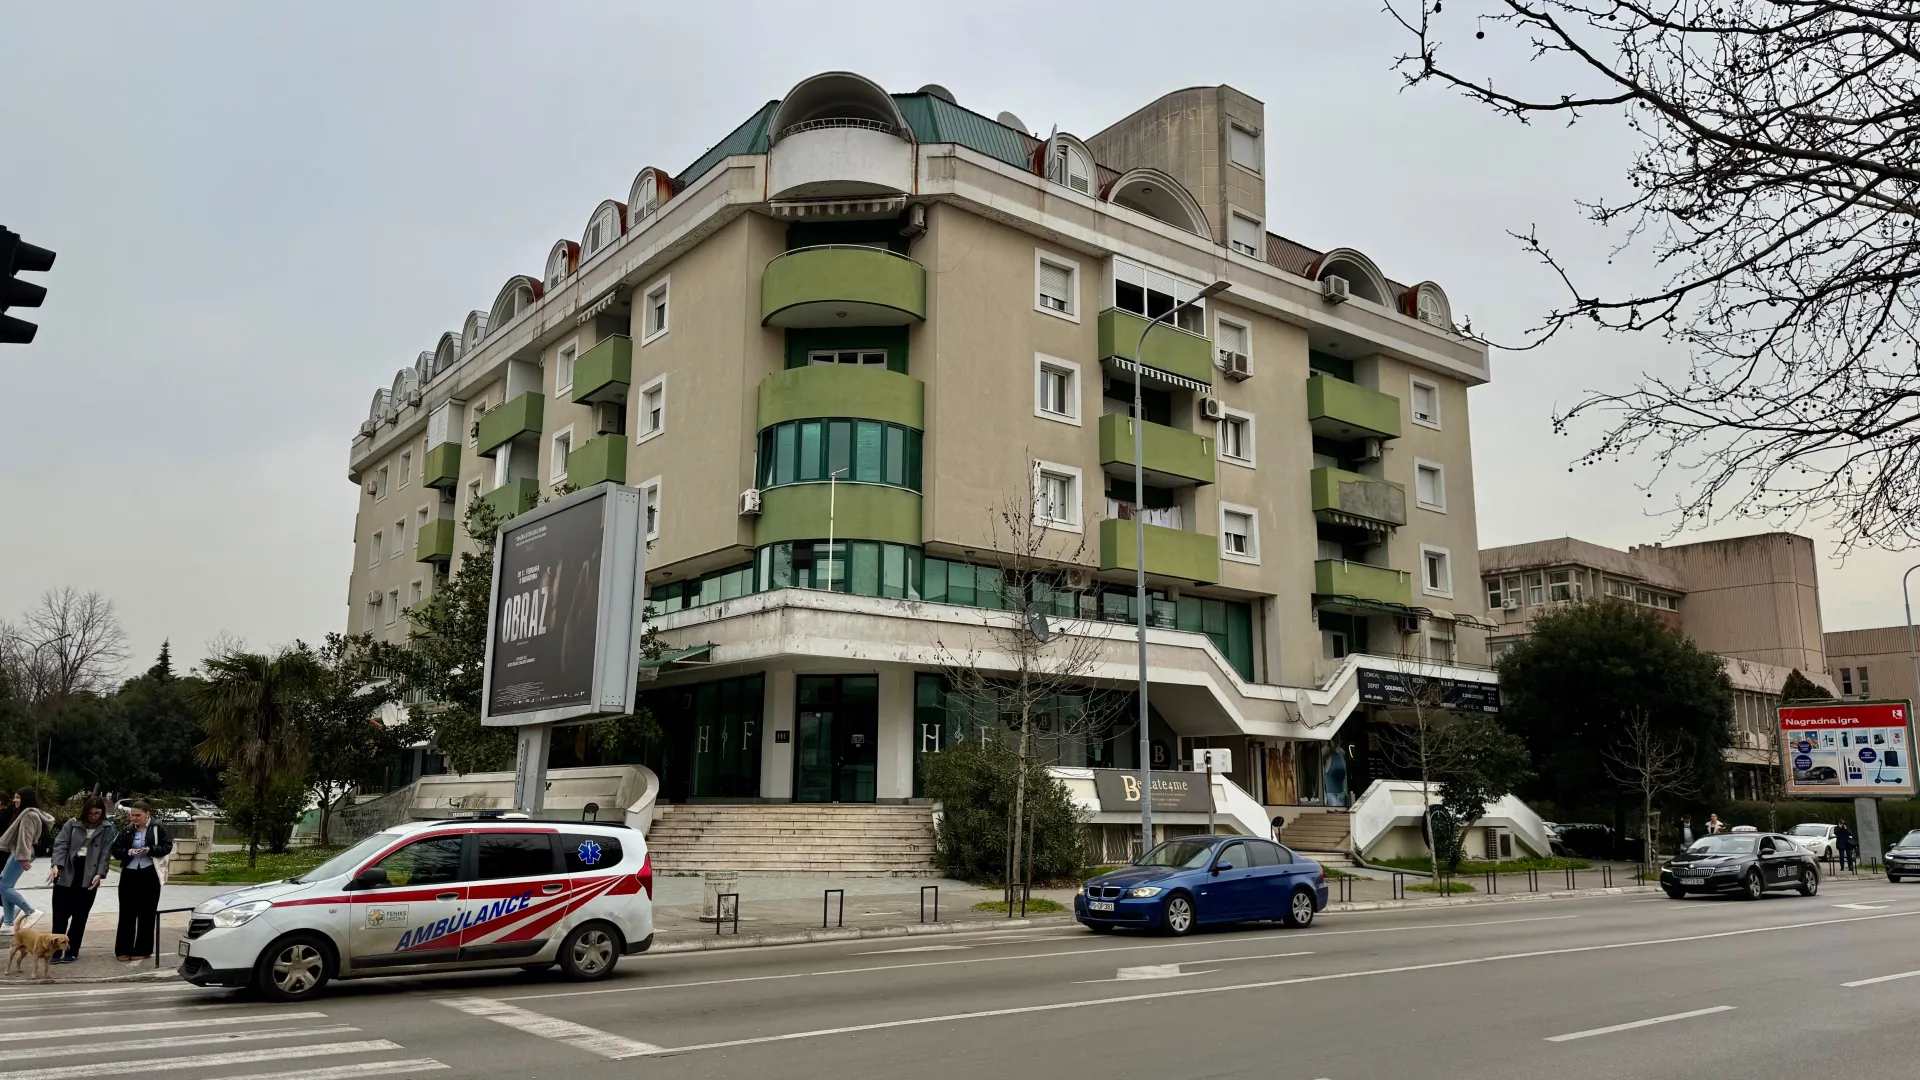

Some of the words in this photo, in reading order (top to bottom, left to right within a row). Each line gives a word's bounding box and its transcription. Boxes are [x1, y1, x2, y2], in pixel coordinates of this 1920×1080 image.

[502, 587, 548, 643] OBRAZ
[697, 725, 710, 753] H
[742, 720, 754, 750] F
[1785, 717, 1837, 726] Nagradna
[1838, 717, 1859, 726] igra
[920, 723, 940, 753] H
[1154, 745, 1165, 763] B
[1120, 775, 1193, 802] Beate4me
[394, 890, 534, 952] AMBULANCE
